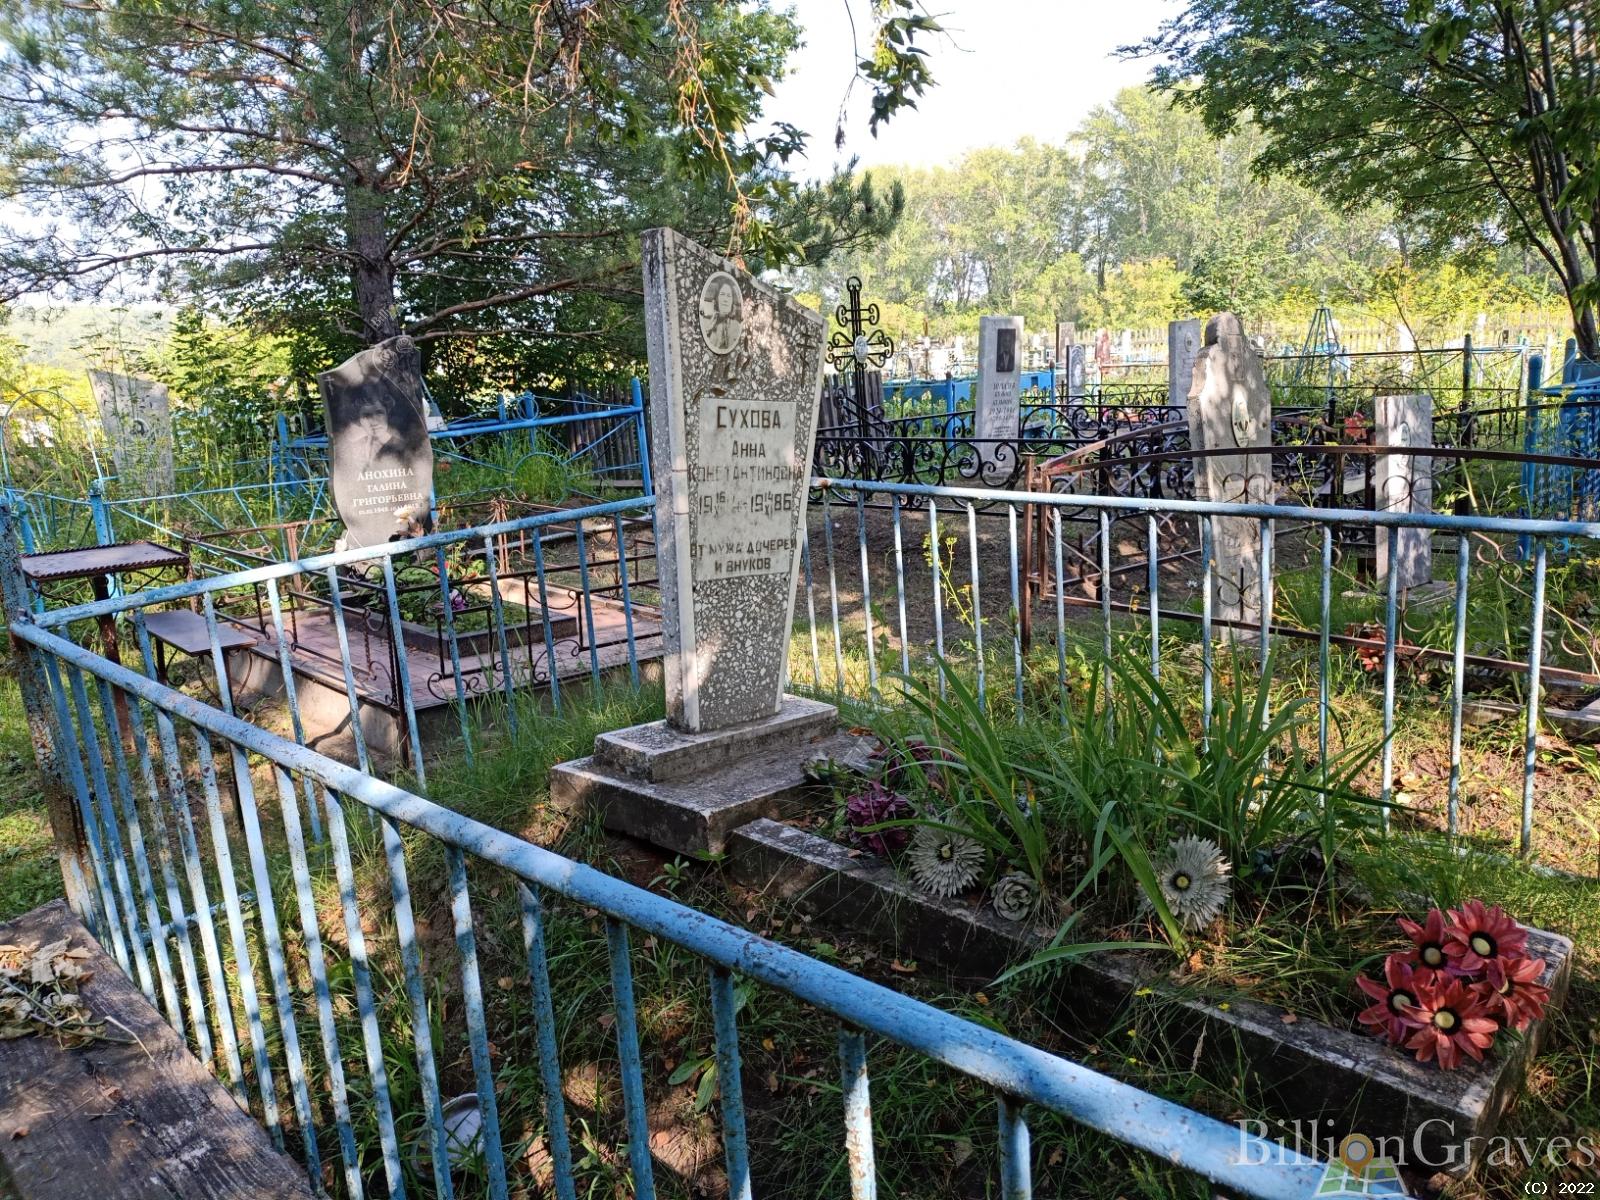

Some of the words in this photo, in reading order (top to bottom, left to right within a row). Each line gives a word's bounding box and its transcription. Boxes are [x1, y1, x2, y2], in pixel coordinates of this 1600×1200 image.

[716, 405, 781, 429] СУХОВА
[731, 439, 766, 459] АННА
[357, 468, 414, 481] АНОХИНА
[367, 481, 407, 493] ГАЛИНА
[352, 492, 424, 508] ГРИГОРЬЕВНА
[726, 556, 772, 573] ВНУКОВ
